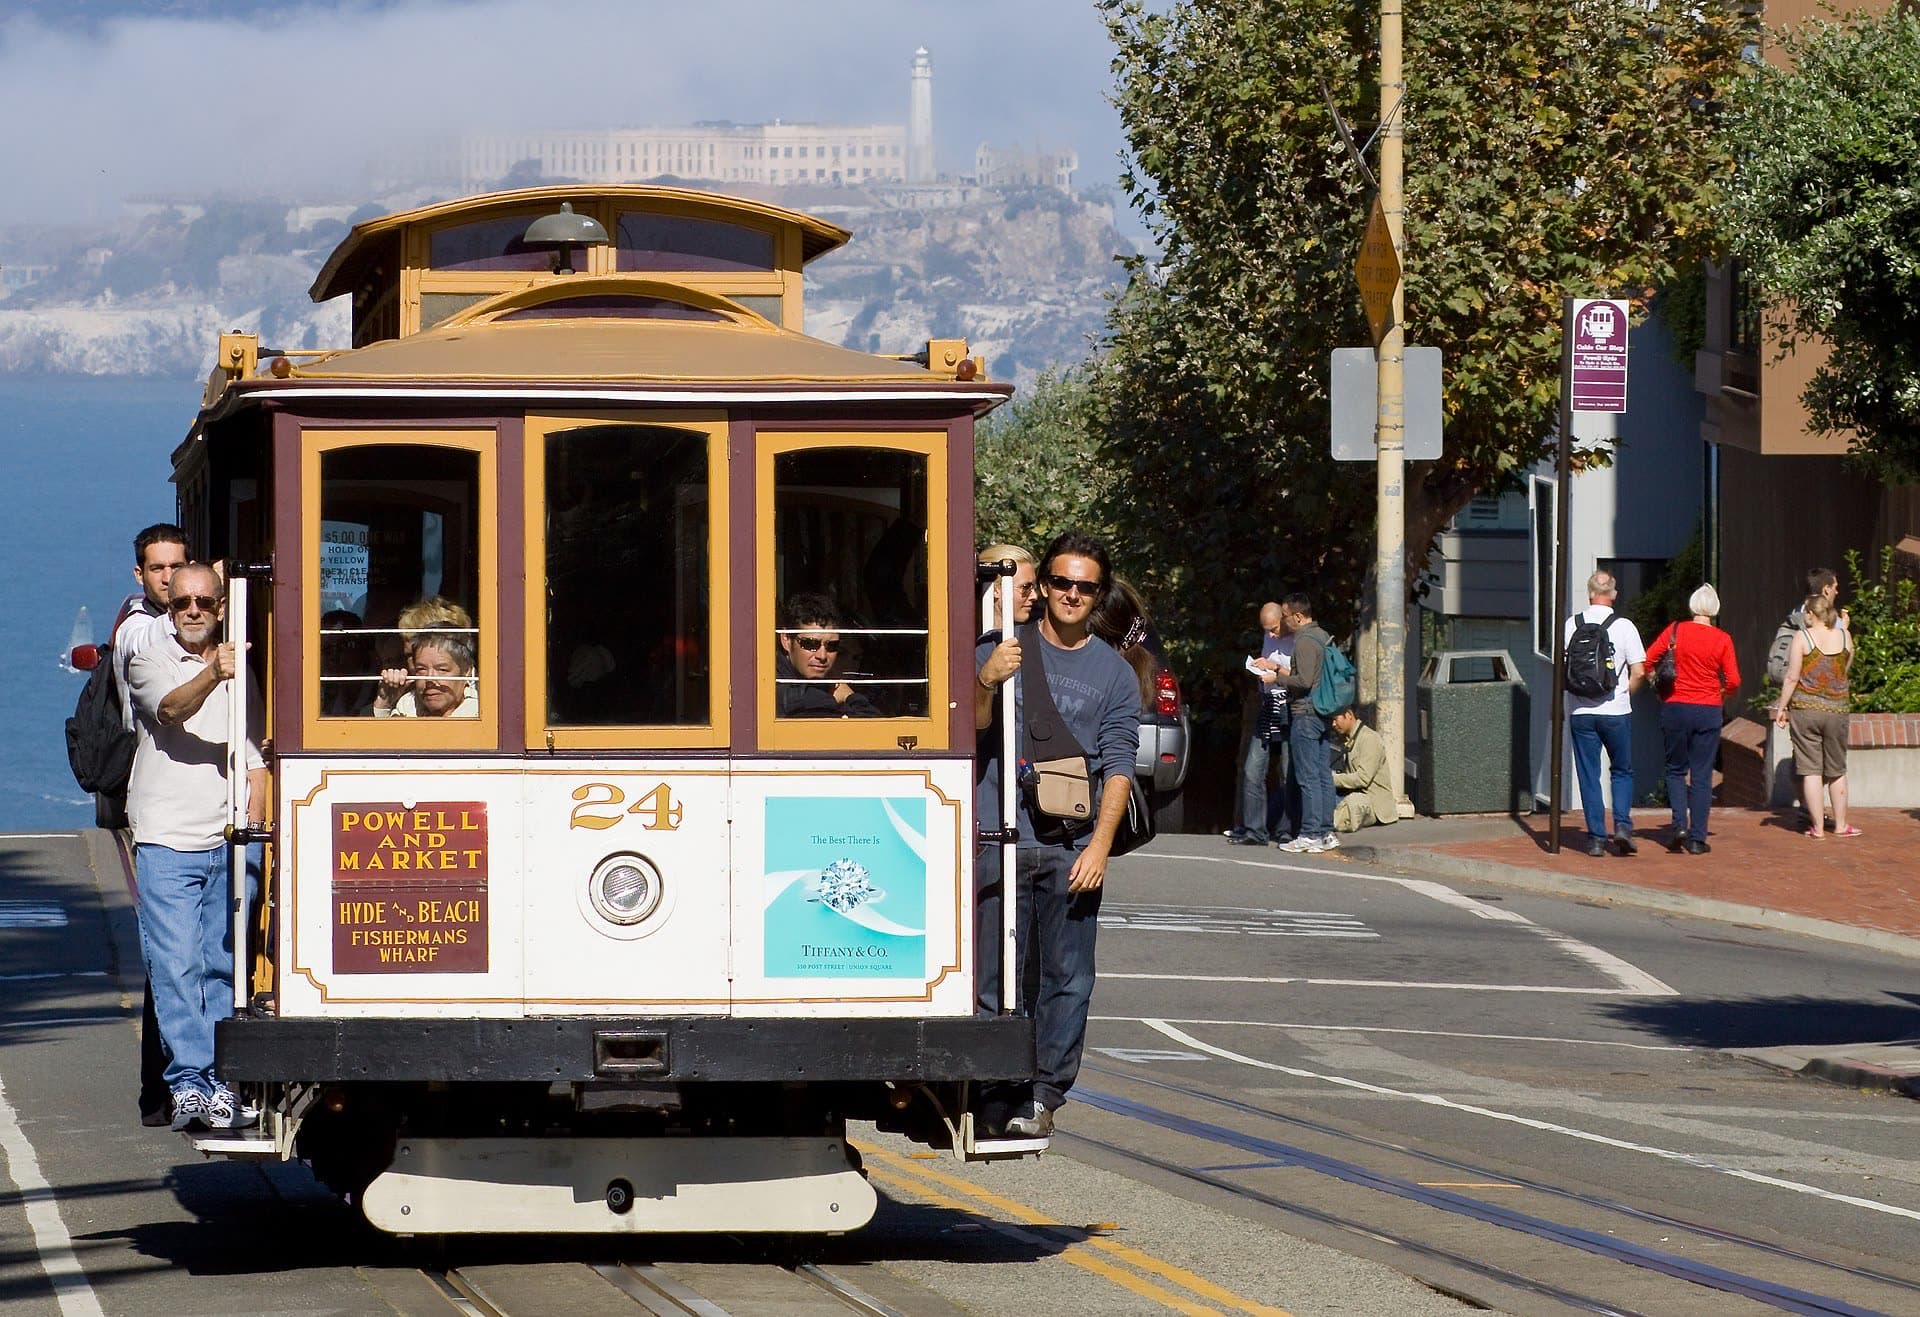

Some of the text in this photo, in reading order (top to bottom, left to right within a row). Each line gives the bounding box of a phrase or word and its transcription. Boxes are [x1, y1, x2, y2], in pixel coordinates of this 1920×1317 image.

[1045, 672, 1104, 703] NIVERSITY
[570, 782, 683, 831] 24
[341, 811, 479, 832] POWELL
[377, 833, 447, 849] AND
[811, 835, 880, 845] The Best There Is
[339, 850, 482, 871] MARKET
[340, 900, 480, 925] HYDE AND BEACH
[351, 928, 468, 946] FISHERMANS
[379, 947, 440, 963] WHARF
